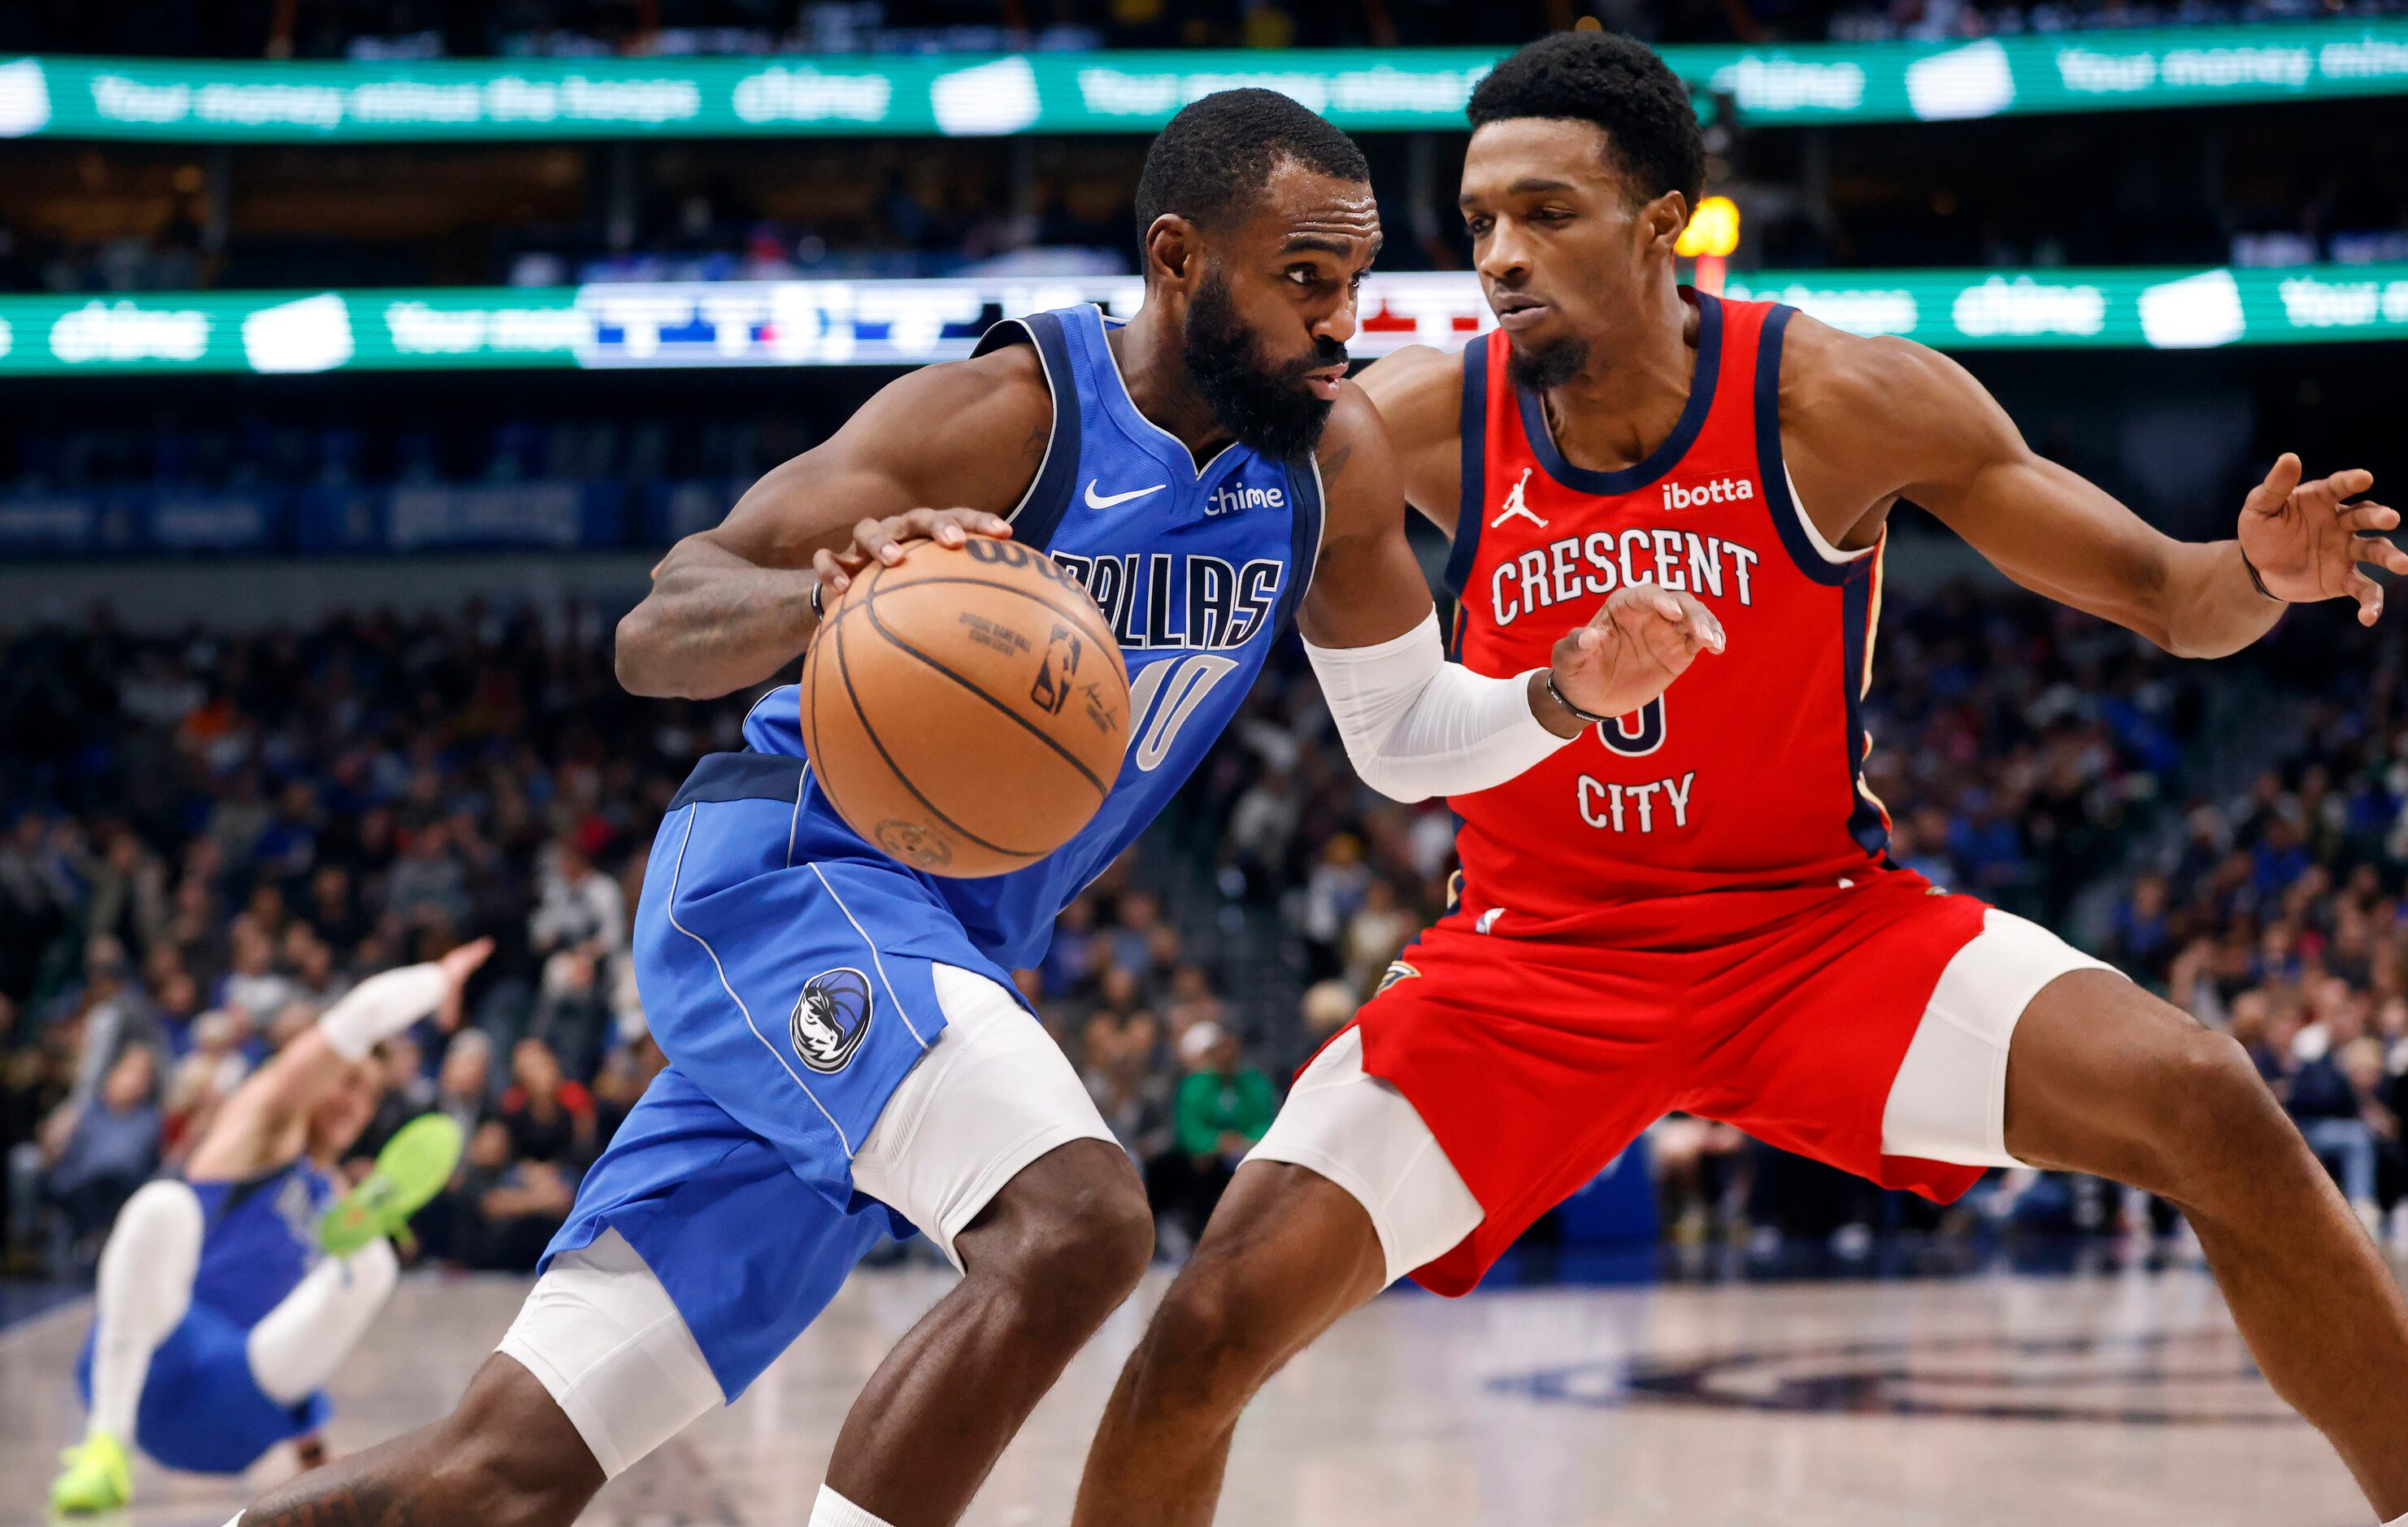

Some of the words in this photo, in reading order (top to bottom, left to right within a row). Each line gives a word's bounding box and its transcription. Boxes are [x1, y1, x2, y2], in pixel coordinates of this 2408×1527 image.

[1204, 482, 1284, 516] chime
[1663, 478, 1754, 510] ibotta
[1491, 529, 1758, 626] CRESCENT
[1577, 771, 1697, 833] CITY
